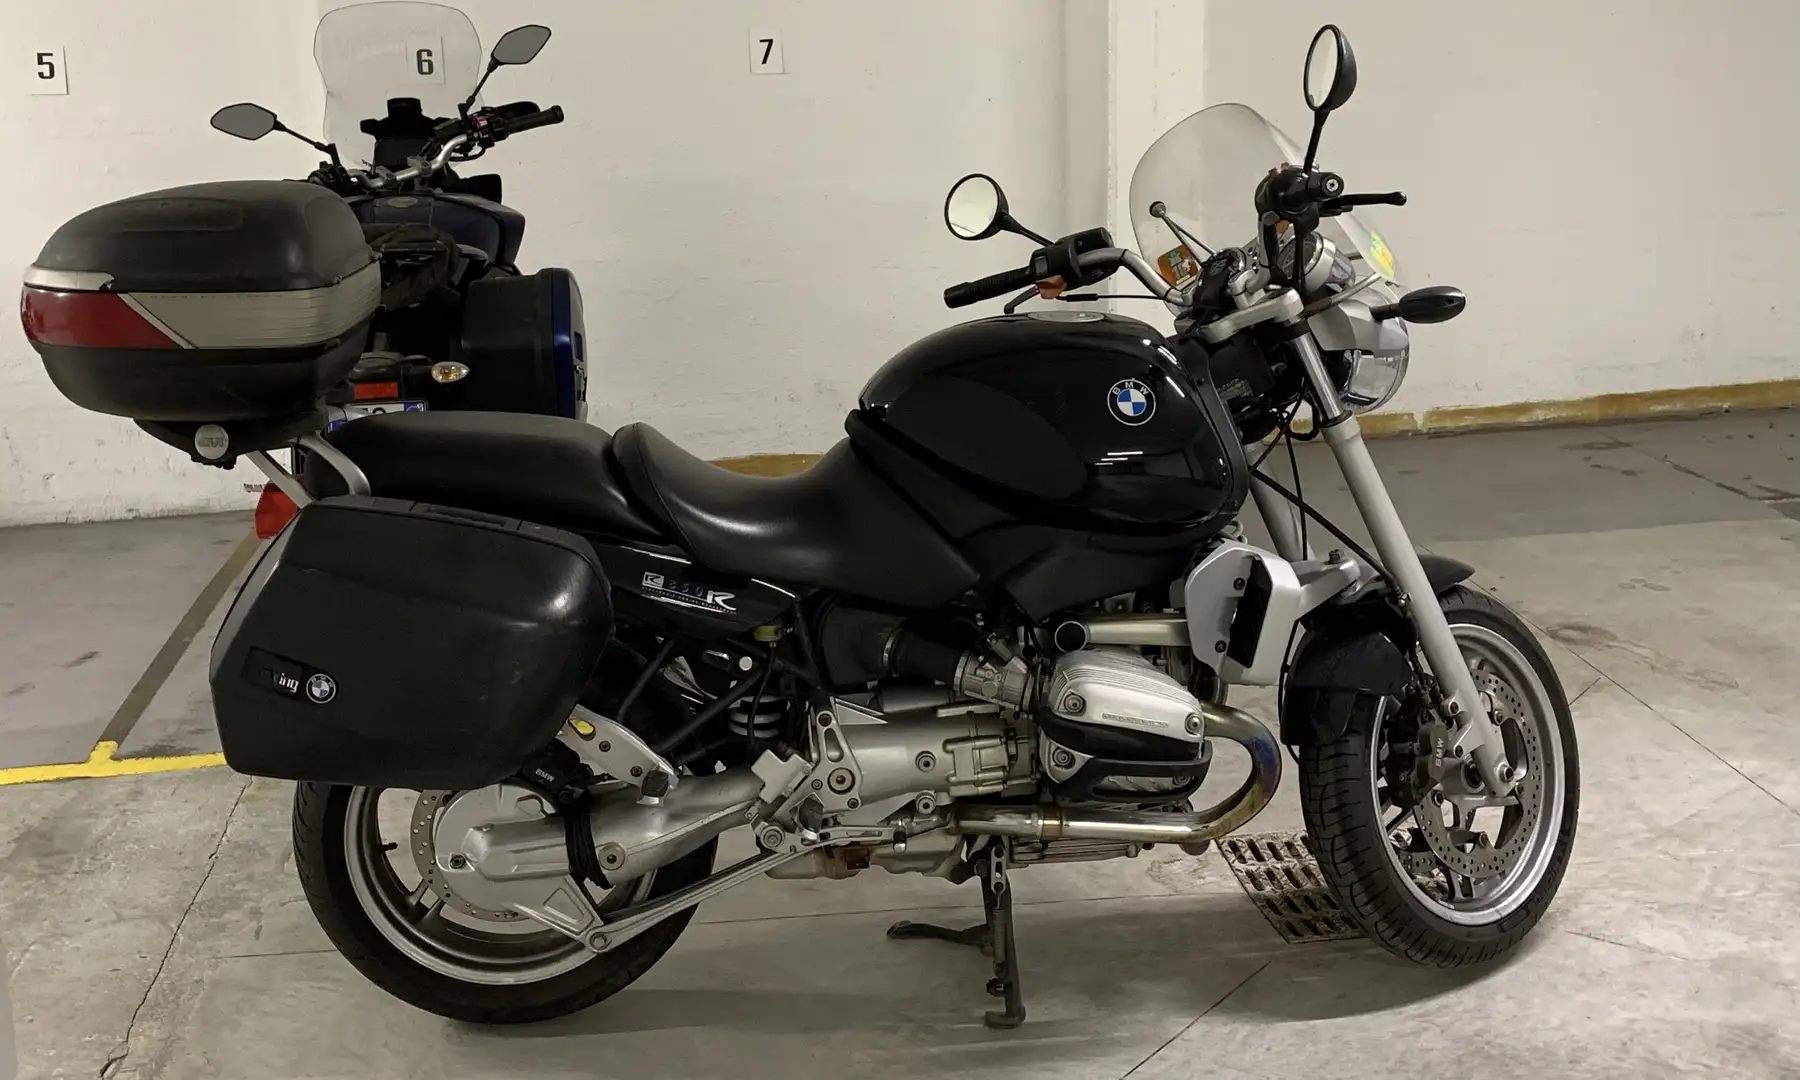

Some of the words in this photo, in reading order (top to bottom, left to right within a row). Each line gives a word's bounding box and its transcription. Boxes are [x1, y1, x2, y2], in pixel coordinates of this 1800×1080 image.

[416, 48, 434, 76] 6
[759, 38, 774, 65] 7
[36, 52, 55, 80] 5
[1111, 381, 1149, 396] BMW
[1434, 737, 1444, 768] BMW
[535, 768, 555, 782] BMW
